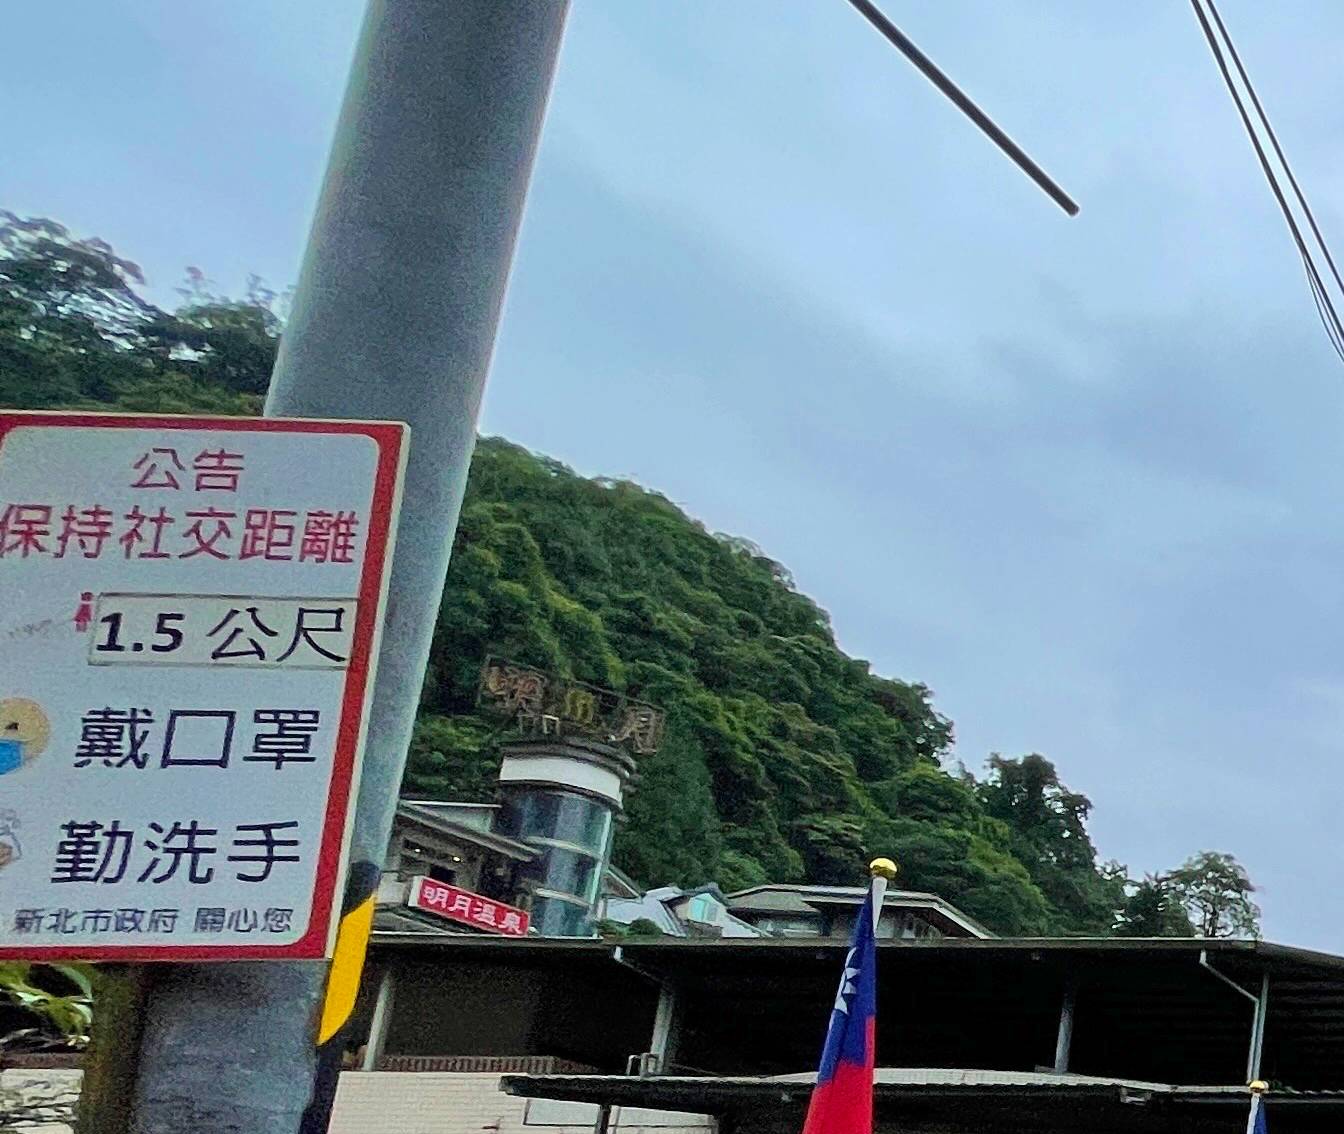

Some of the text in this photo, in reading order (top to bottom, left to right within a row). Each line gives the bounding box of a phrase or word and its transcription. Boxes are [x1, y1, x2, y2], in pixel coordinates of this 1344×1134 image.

[130, 447, 246, 492] 公告
[0, 503, 360, 564] 保持社交距離
[96, 607, 347, 662] 1.5 公尺
[73, 706, 320, 770] 戴口罩
[51, 820, 300, 884] 勤洗手
[13, 907, 181, 935] 新北市政府
